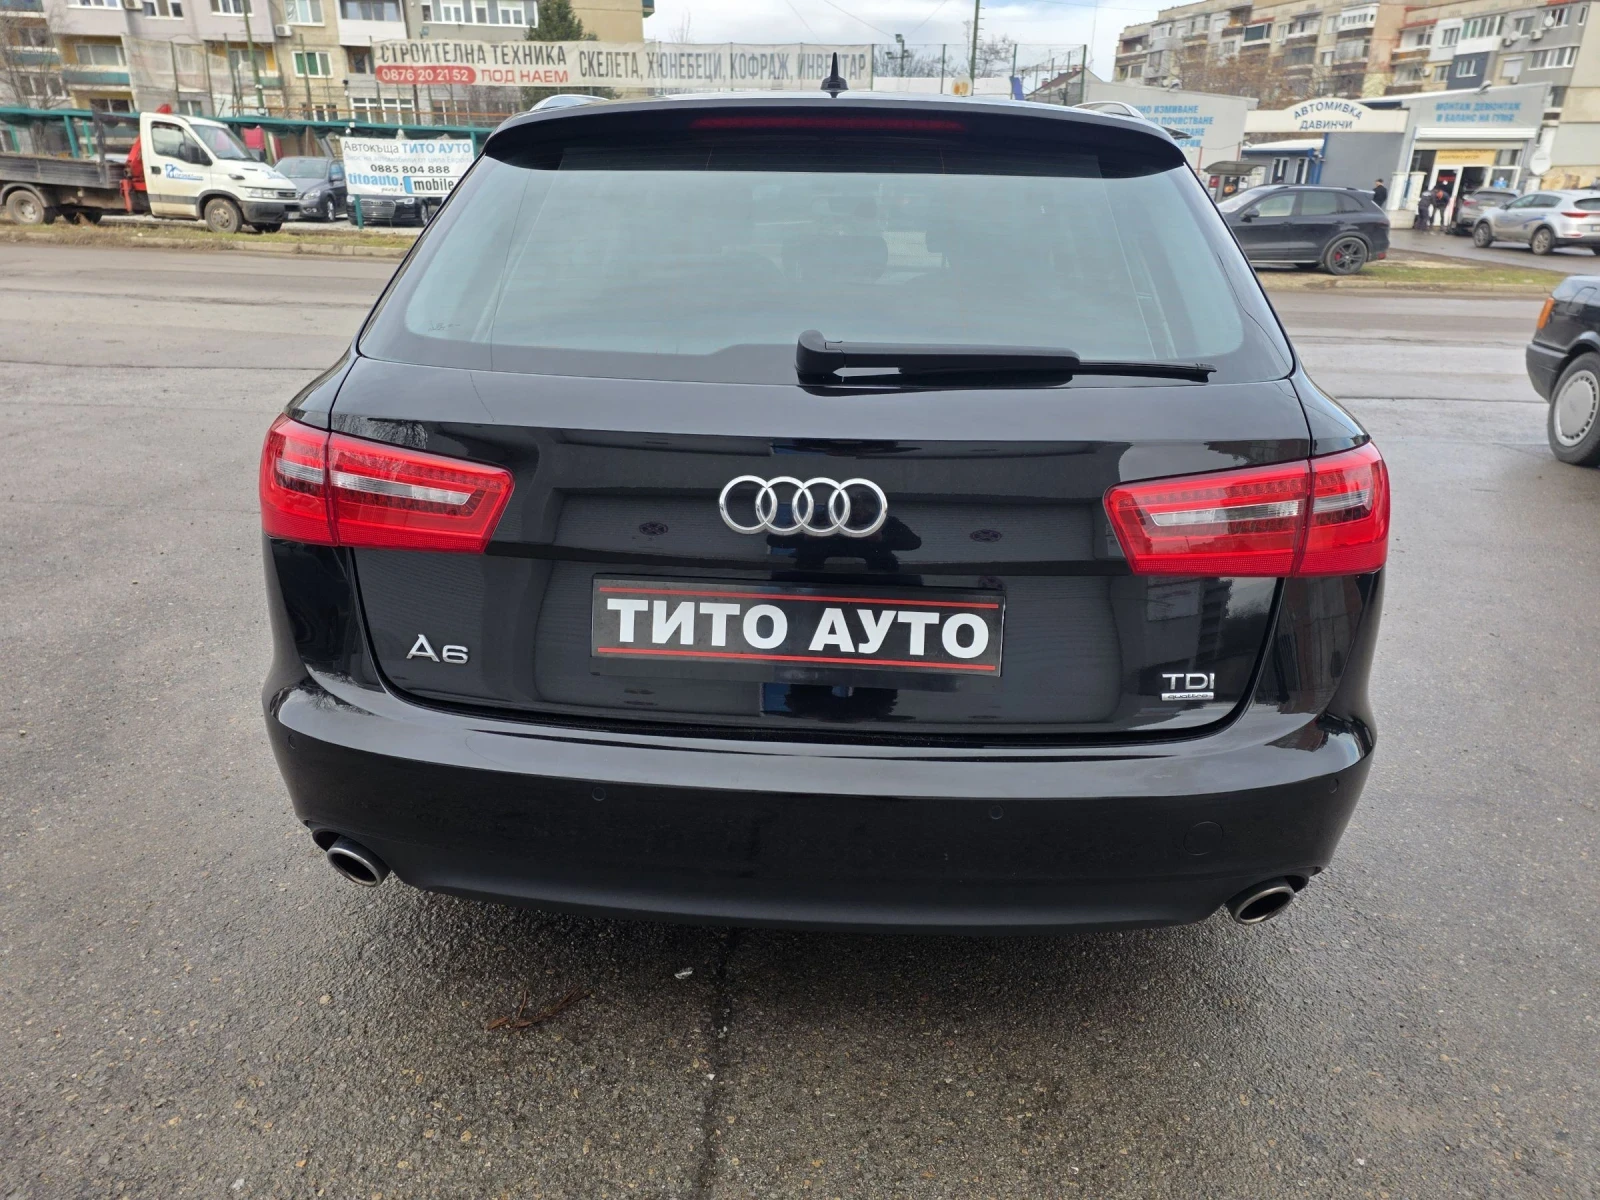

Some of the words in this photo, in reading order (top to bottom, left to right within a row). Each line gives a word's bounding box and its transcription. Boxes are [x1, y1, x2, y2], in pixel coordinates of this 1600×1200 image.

[380, 43, 487, 65] СТРОИТЕЛНА
[491, 45, 567, 66] ТЕХНИКА
[579, 50, 644, 79] СКЕЛЕТА,
[730, 53, 794, 82] КОФРАЖ,
[382, 69, 415, 81] 0876
[418, 70, 434, 82] 20
[437, 70, 450, 82] 21
[452, 70, 469, 82] 52
[481, 69, 516, 84] ПОД
[520, 70, 569, 83] НАЕМ
[1294, 102, 1363, 120] АВТОМИВКА
[1300, 120, 1353, 130] ДАВИНЧИ
[402, 143, 435, 154] ТИТО
[438, 143, 471, 154] АУТО
[370, 164, 399, 173] 0885
[402, 165, 425, 174] 804
[427, 166, 450, 174] 888
[413, 178, 460, 192] mobile
[607, 598, 788, 649] ТИТО
[808, 608, 989, 659] АУТО
[406, 633, 469, 664] A6
[1162, 672, 1215, 690] TDI
